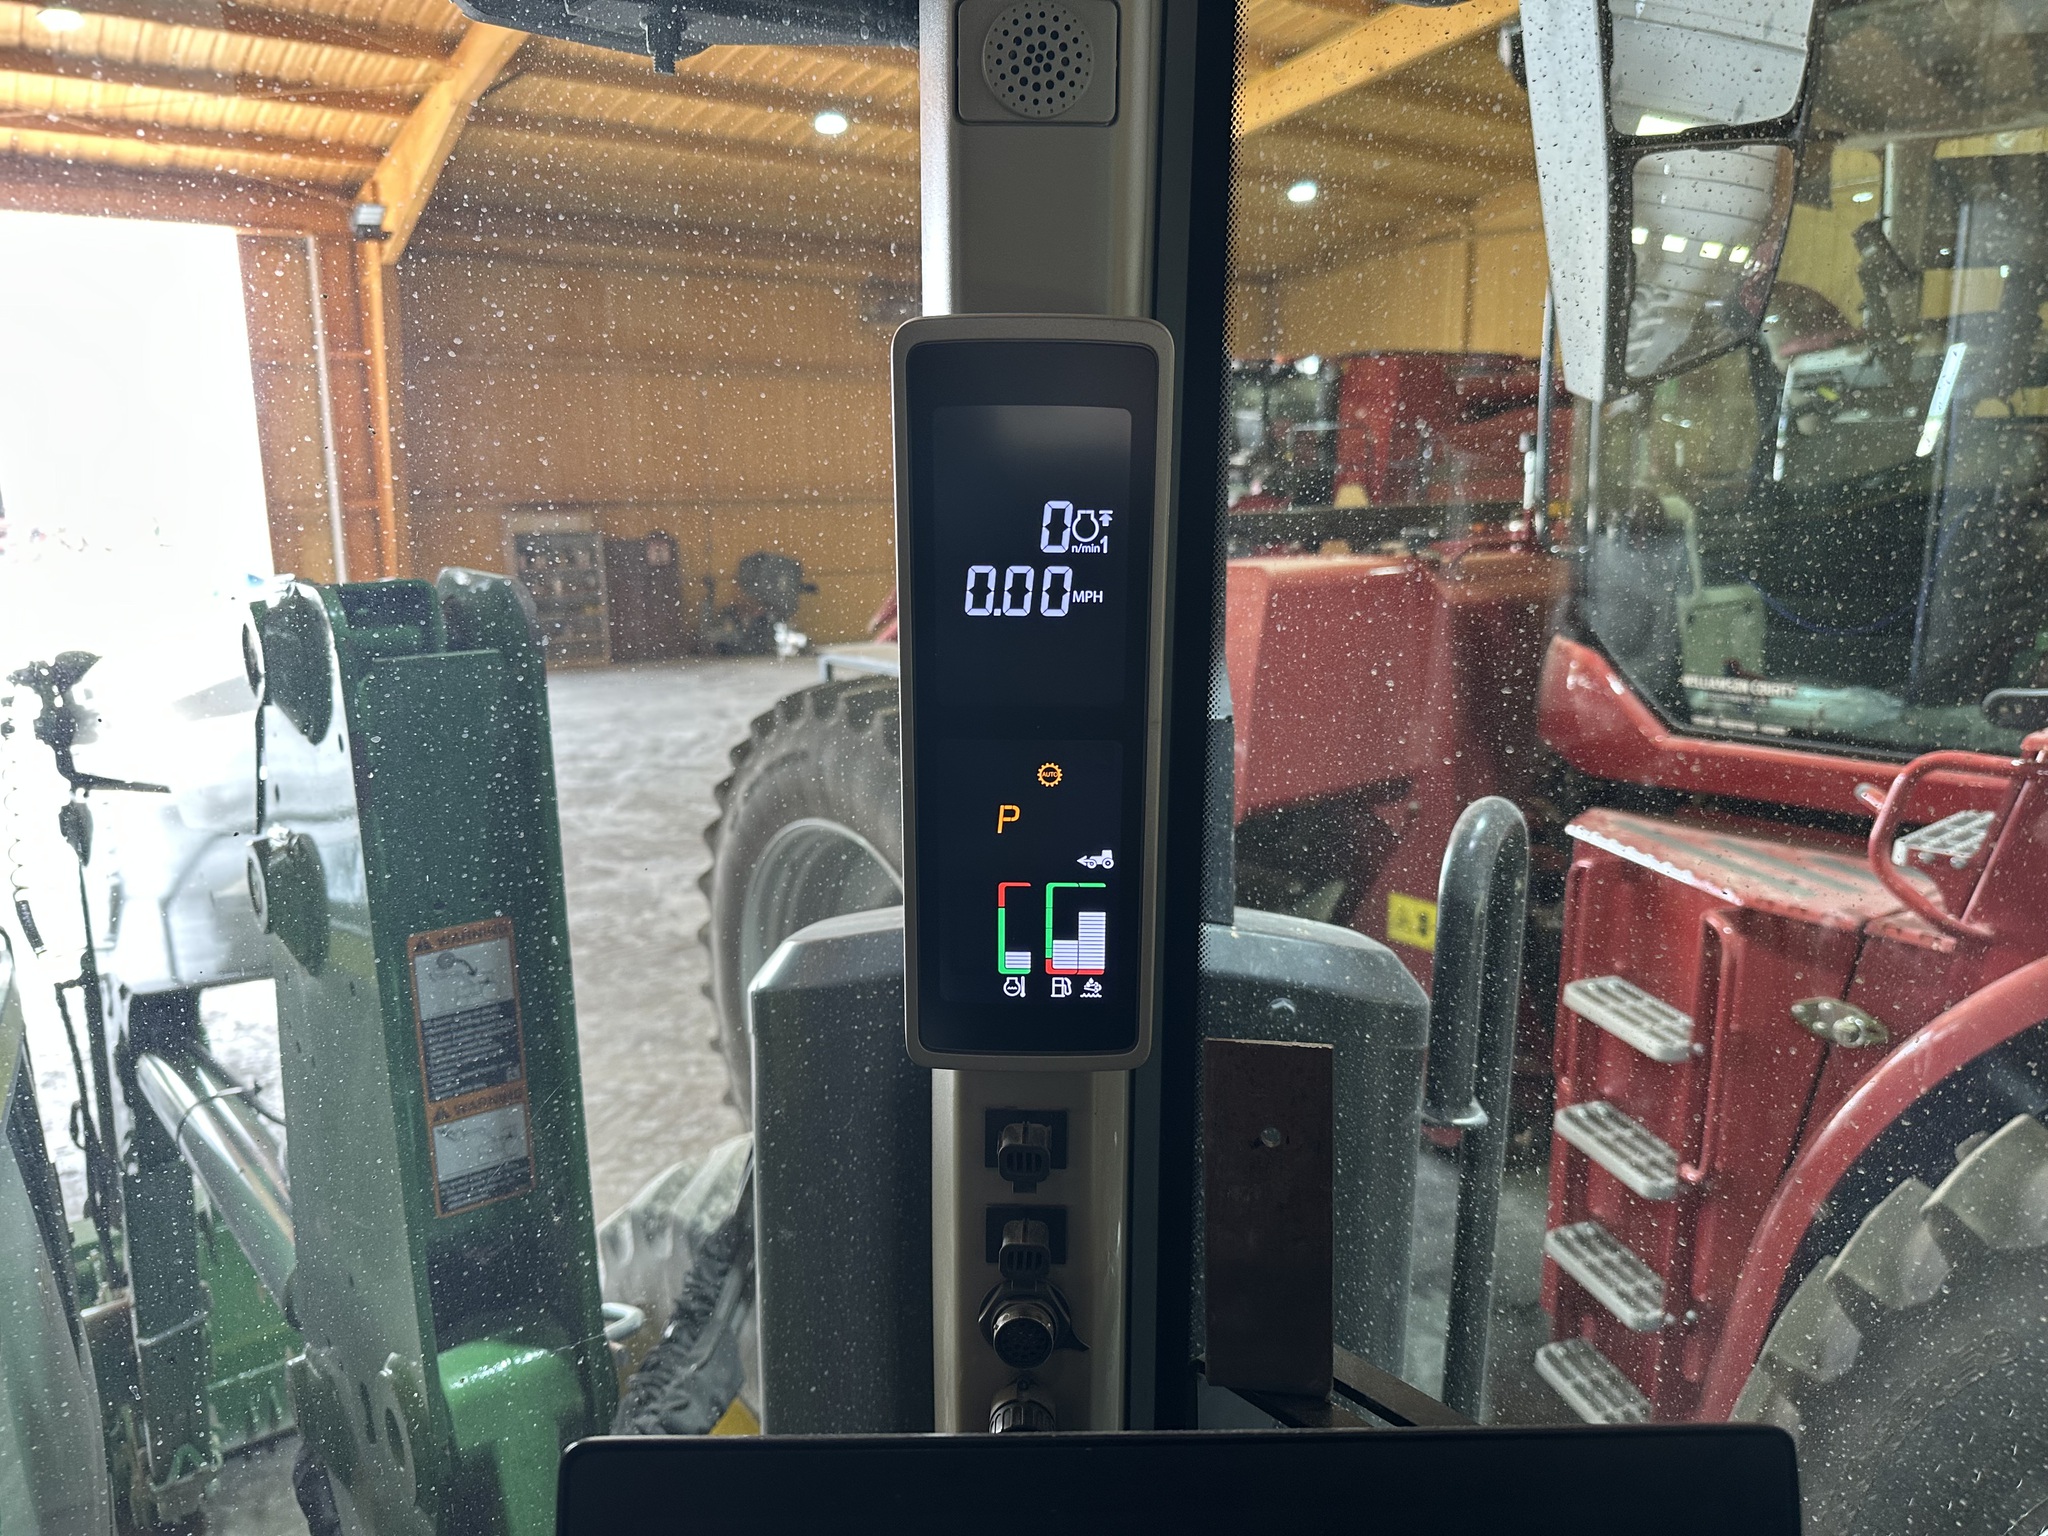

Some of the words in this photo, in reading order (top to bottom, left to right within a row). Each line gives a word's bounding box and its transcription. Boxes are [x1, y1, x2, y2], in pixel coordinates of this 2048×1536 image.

[1040, 500, 1074, 553] 0
[1071, 543, 1101, 554] n/min
[964, 565, 1073, 617] 0.00
[1072, 590, 1104, 604] MPH
[997, 804, 1021, 834] P
[438, 923, 508, 947] WARNING
[454, 1087, 522, 1115] WARNING
